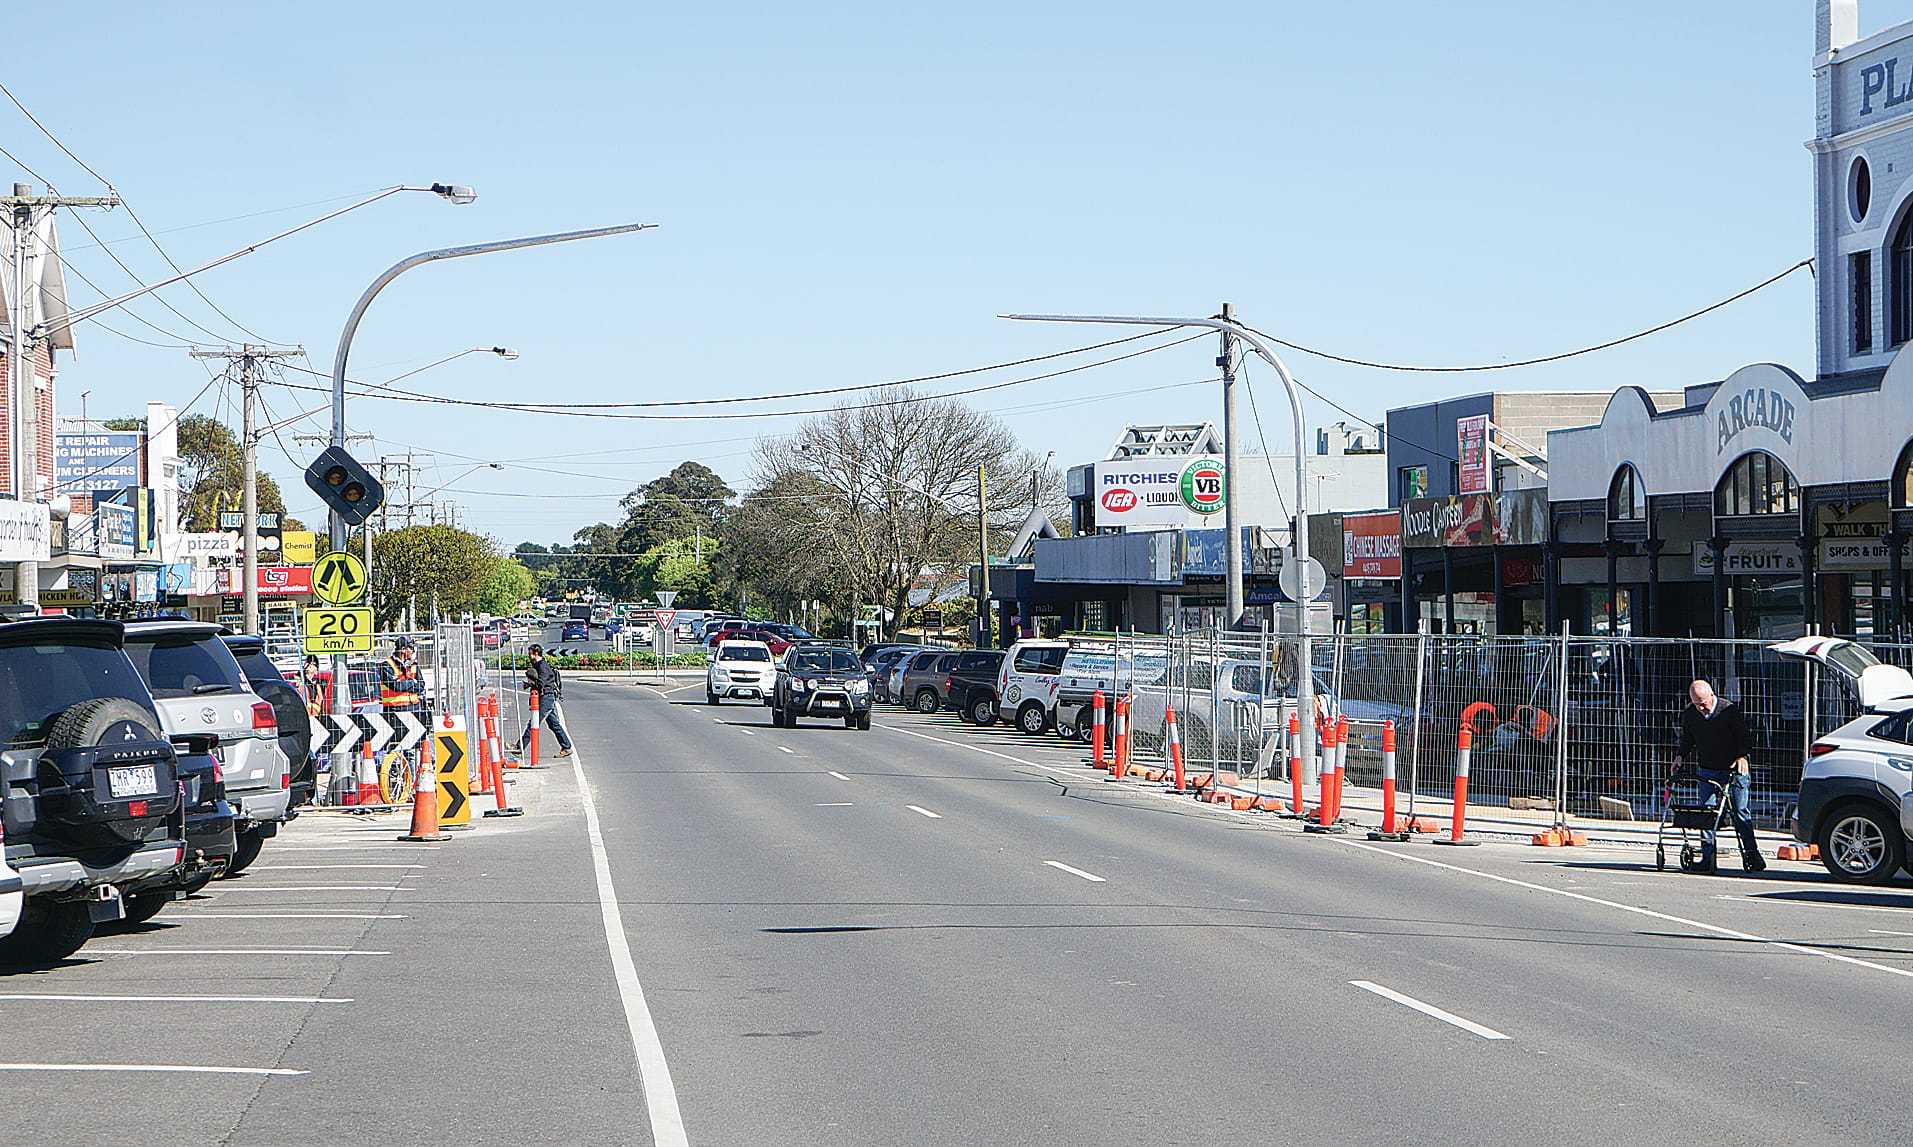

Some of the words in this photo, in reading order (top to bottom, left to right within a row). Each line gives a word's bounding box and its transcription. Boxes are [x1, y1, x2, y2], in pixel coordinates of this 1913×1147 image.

[1717, 387, 1796, 455] ARCADE
[65, 436, 110, 446] REPAIR
[70, 447, 135, 457] MACHINES
[73, 466, 136, 476] CLEANERS
[1103, 473, 1178, 485] RITCHIES
[1194, 478, 1221, 494] VB
[1106, 493, 1133, 508] IGA
[1833, 523, 1866, 537] WALK
[187, 536, 231, 554] pizza
[284, 541, 313, 550] Chemist
[1353, 534, 1374, 558] CHINESE
[1374, 533, 1400, 558] MASSAGE
[1829, 546, 1860, 558] SHOPS
[1862, 546, 1870, 557] &
[1729, 555, 1783, 569] FRUIT
[1786, 557, 1795, 569] &
[40, 592, 67, 601] HICKEN
[1249, 592, 1283, 601] Amcal
[1035, 603, 1054, 613] nab
[319, 613, 358, 635] 20
[323, 640, 355, 649] km/h
[135, 769, 153, 785] 599
